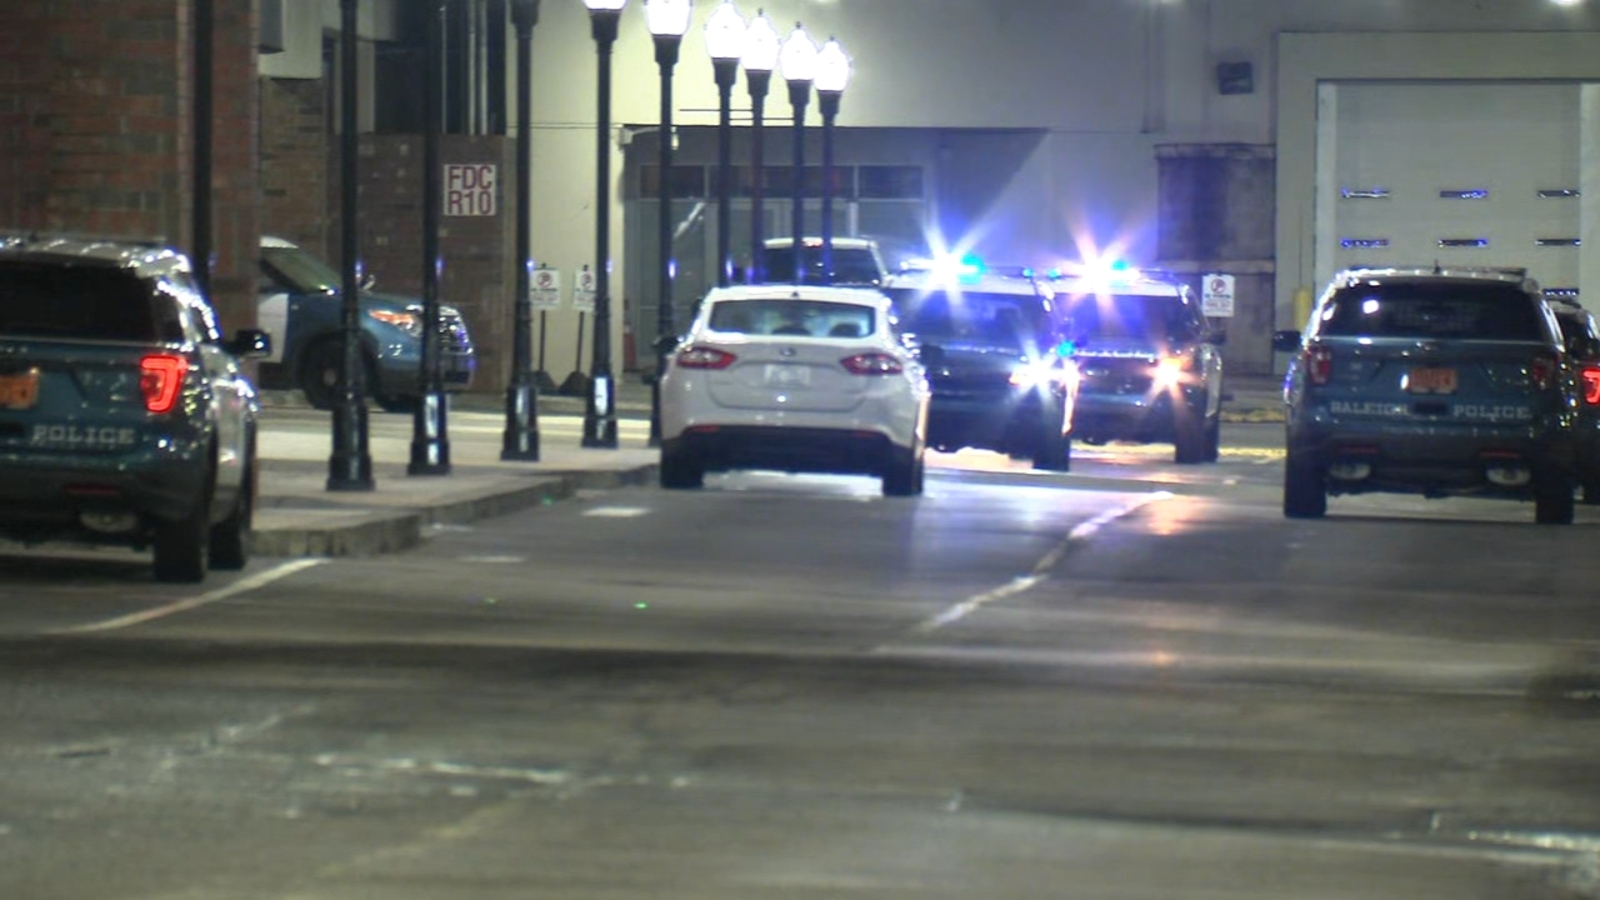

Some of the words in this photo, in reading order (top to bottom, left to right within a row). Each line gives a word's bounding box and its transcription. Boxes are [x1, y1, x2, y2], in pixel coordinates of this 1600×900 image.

[448, 165, 492, 189] FDC
[448, 190, 492, 214] R10
[1330, 401, 1409, 417] RALEIGH
[1453, 403, 1530, 420] POLICE
[32, 425, 133, 445] POLICE
